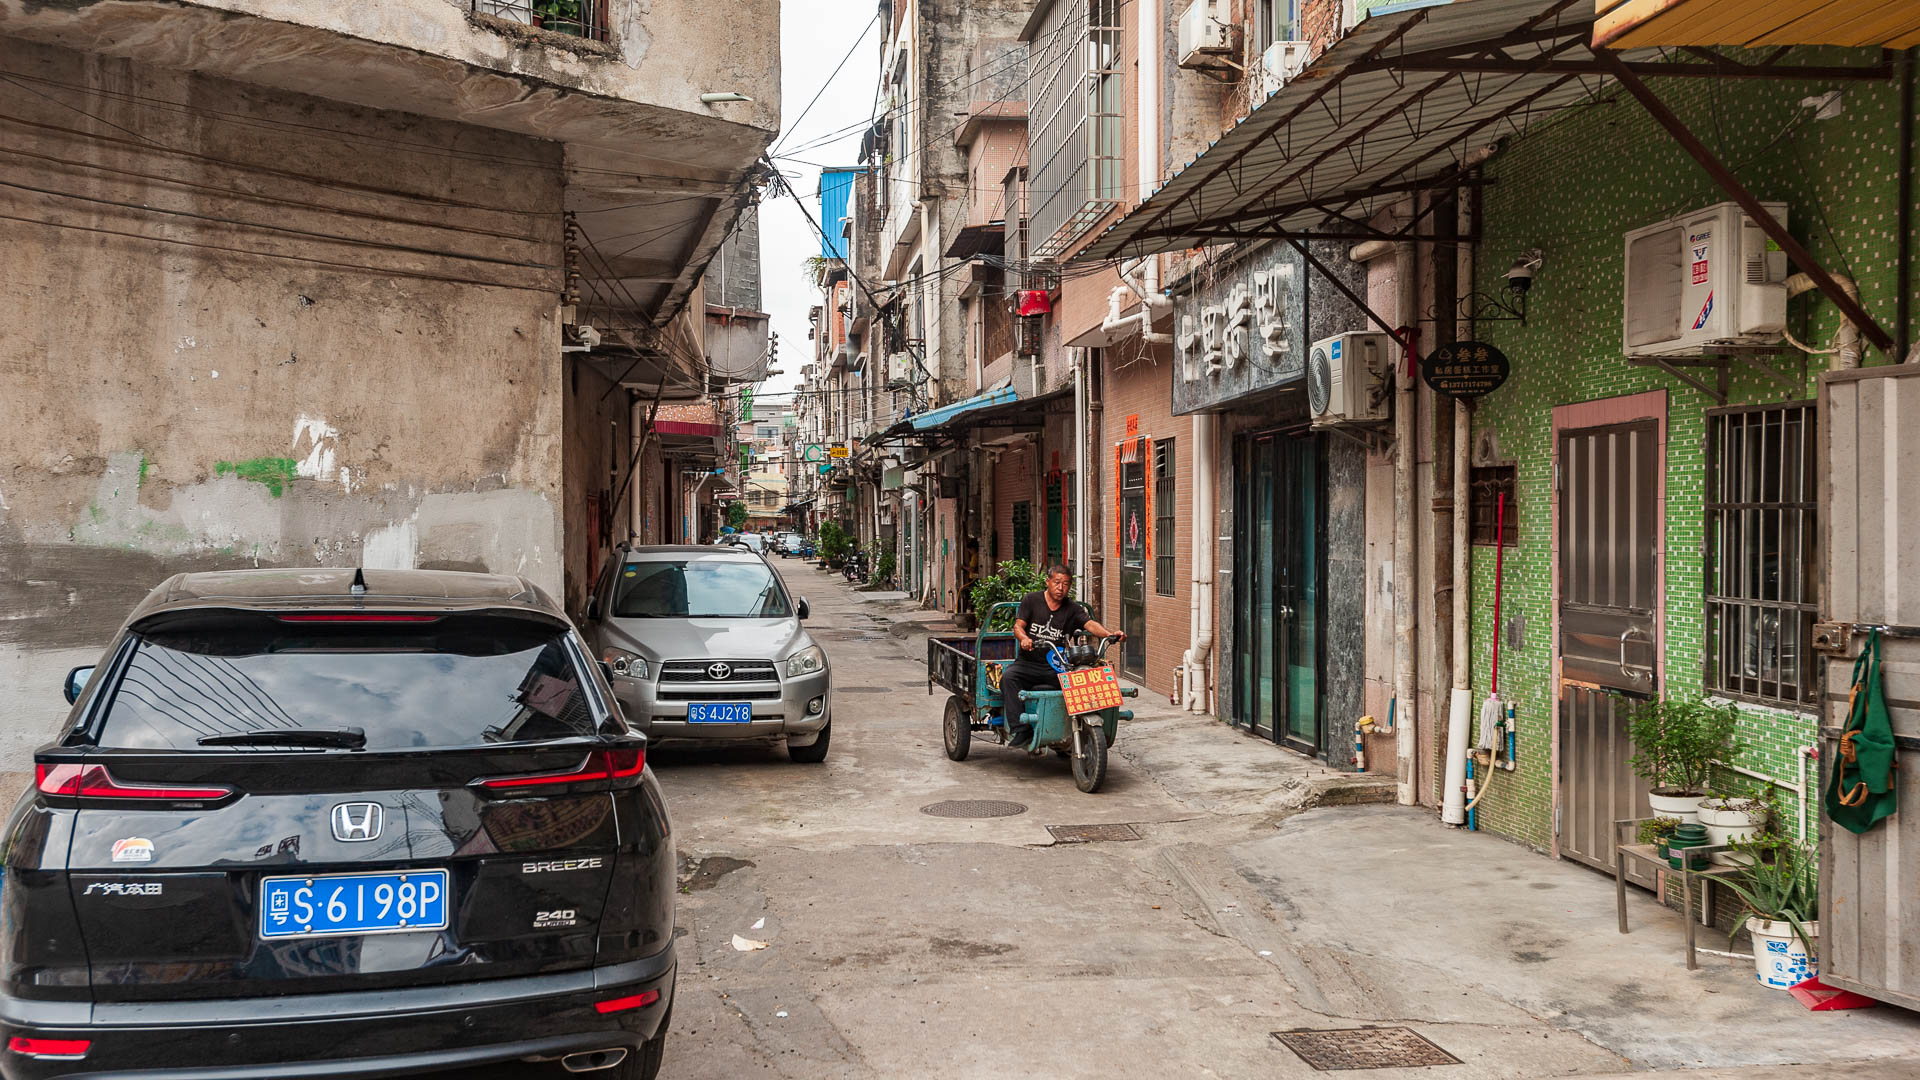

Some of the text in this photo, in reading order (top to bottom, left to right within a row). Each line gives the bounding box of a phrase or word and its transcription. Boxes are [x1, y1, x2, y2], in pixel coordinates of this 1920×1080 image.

[1071, 670, 1104, 686] 回收
[522, 858, 602, 873] BREEZE
[83, 883, 162, 895] 广汽本田
[536, 910, 575, 921] 240
